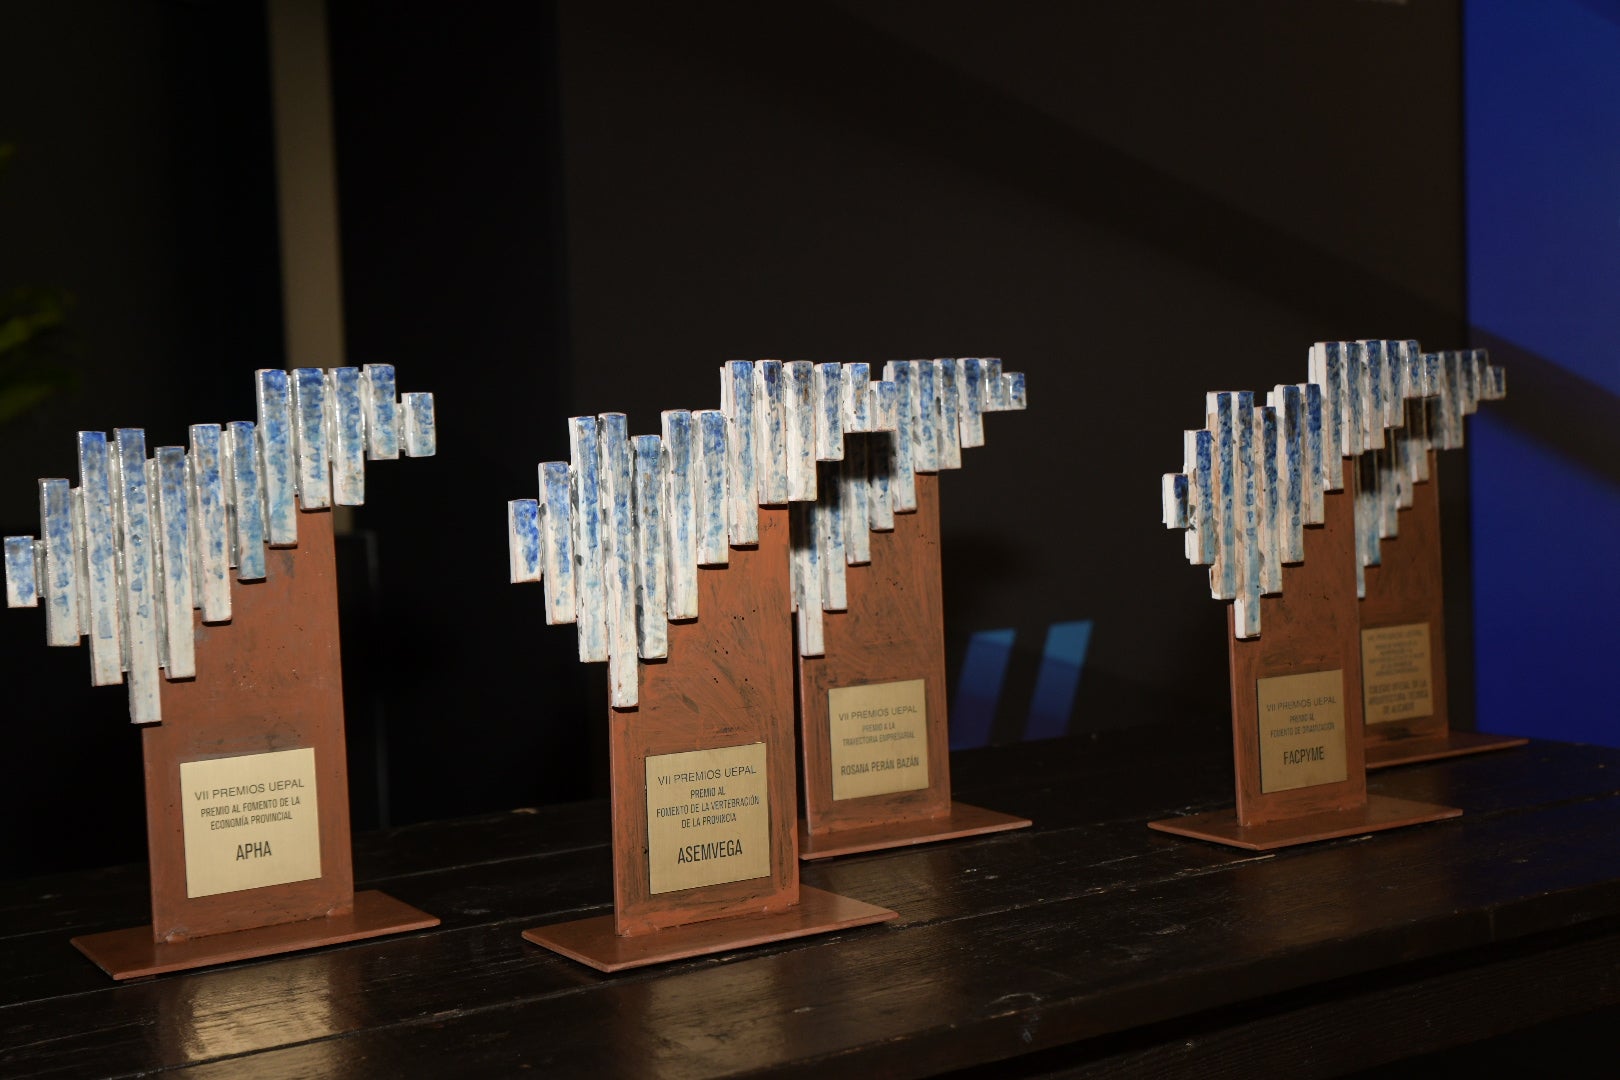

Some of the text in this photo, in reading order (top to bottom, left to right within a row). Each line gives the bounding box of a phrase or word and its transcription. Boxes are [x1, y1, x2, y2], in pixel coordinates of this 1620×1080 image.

[851, 708, 889, 719] PREMIOS
[891, 705, 917, 715] UEPAL
[1278, 699, 1311, 710] PREMIOS
[1314, 696, 1336, 706] UEPAL
[863, 723, 882, 732] PREMIO
[843, 736, 878, 746] TRAYECTORIA
[1284, 746, 1324, 765] FACPYME
[841, 763, 869, 776] ROSANA
[897, 755, 920, 768] BAZÁN
[658, 766, 756, 785] VII PREMIOS UEPAL
[194, 779, 304, 800] VII PREMIOS UEPAL
[691, 786, 725, 799] PREMIO AL
[201, 796, 300, 817] PREMIO AL FOMENTO DE LA
[657, 795, 760, 818] FOMENTO DE LA VERTEBRACIÓN
[210, 811, 292, 830] ECONOMÍA PROVINCIAL
[682, 813, 736, 828] DE LA PROVINCIA
[236, 841, 272, 860] APHA
[678, 839, 742, 864] ASEMVEGA
